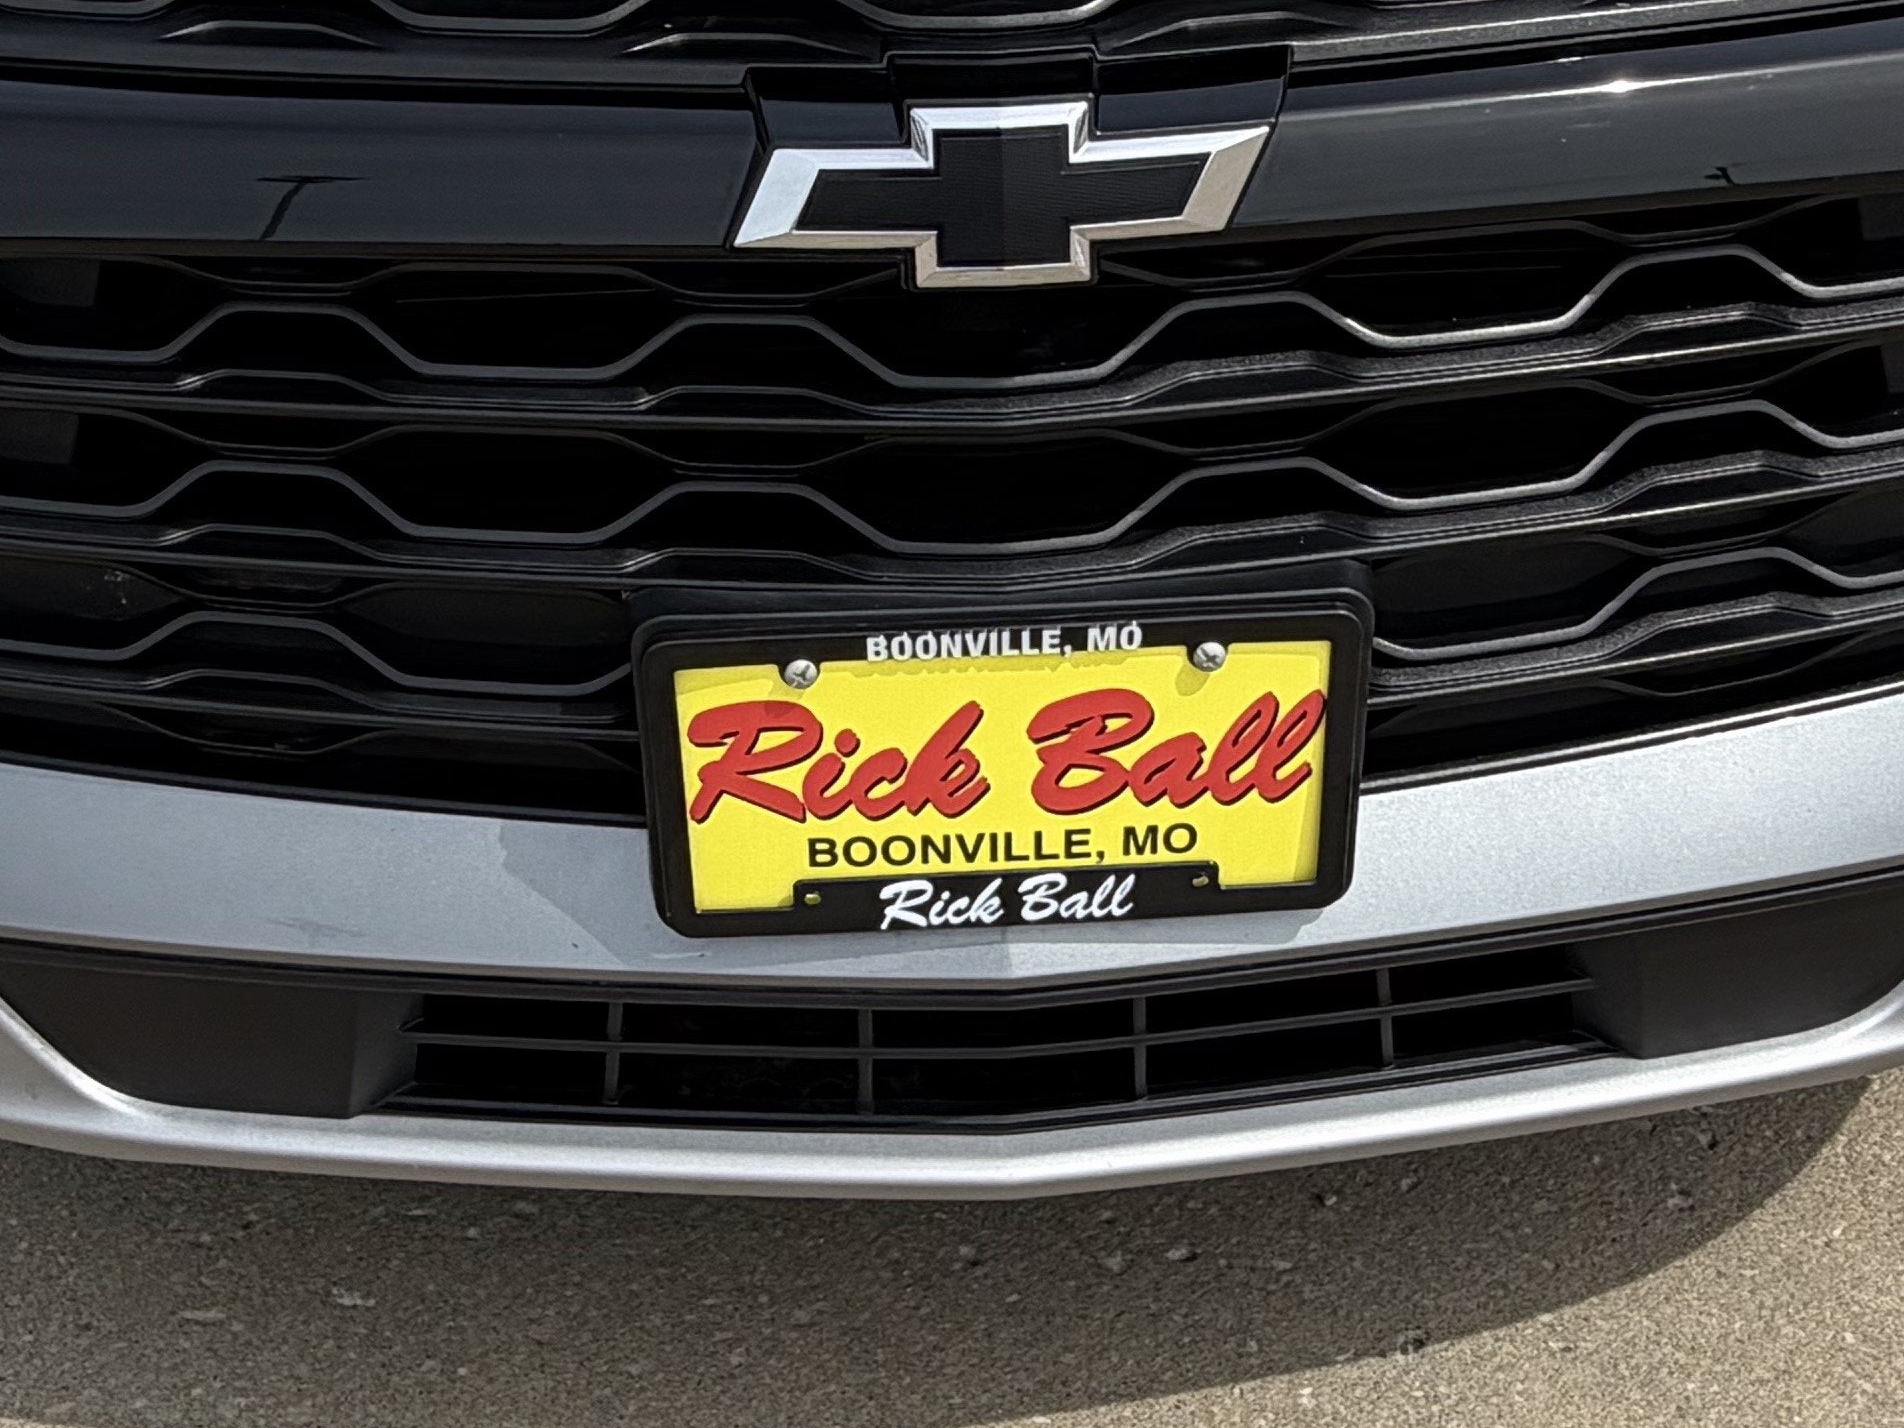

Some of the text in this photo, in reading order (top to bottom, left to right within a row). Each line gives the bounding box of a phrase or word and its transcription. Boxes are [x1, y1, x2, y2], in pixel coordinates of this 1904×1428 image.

[865, 620, 1144, 663] BOONVILLE, MO
[688, 688, 1328, 824] Rick Ball
[806, 822, 1198, 868] BOONVILLE, MO
[879, 872, 1137, 931] Rick Ball
